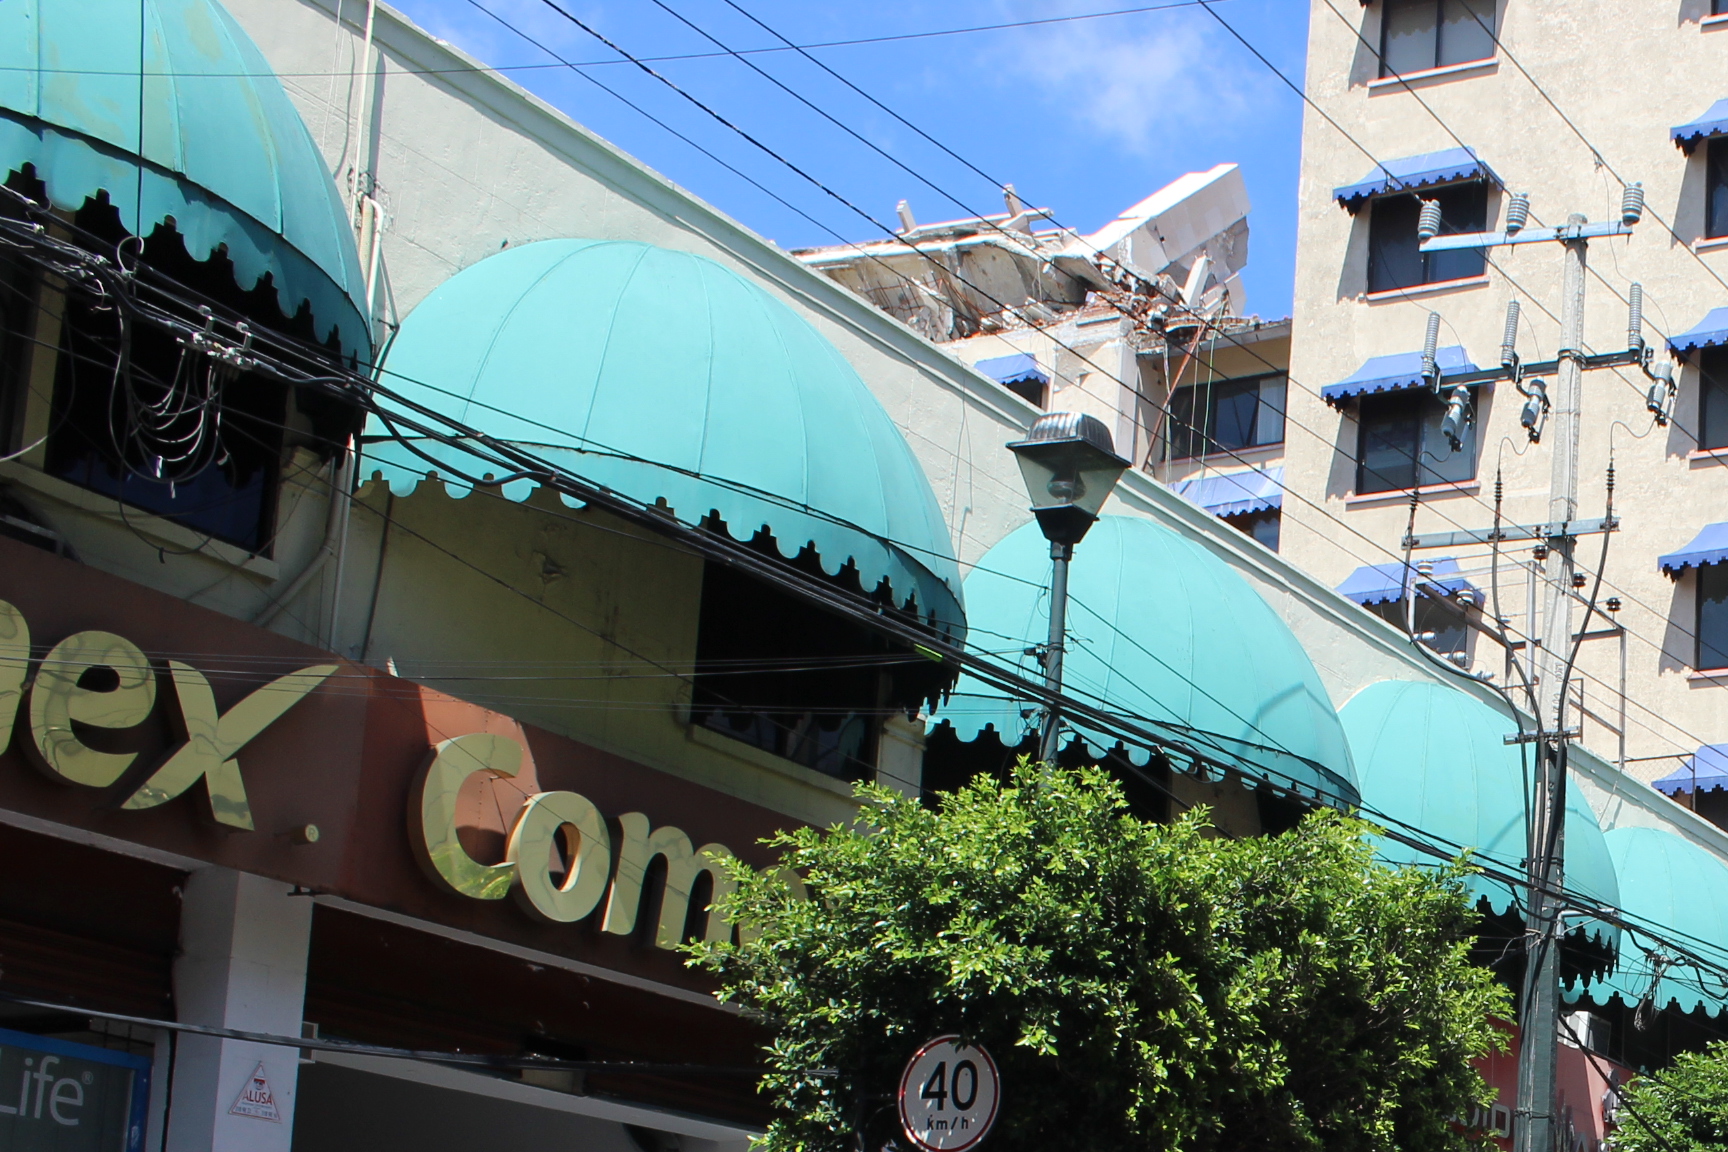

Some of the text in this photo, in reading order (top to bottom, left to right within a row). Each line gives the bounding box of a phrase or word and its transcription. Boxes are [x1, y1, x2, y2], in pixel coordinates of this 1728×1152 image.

[0, 604, 338, 830] ex
[243, 1090, 273, 1106] ALUSA
[921, 1059, 978, 1111] 40
[926, 1115, 969, 1130] km/h
